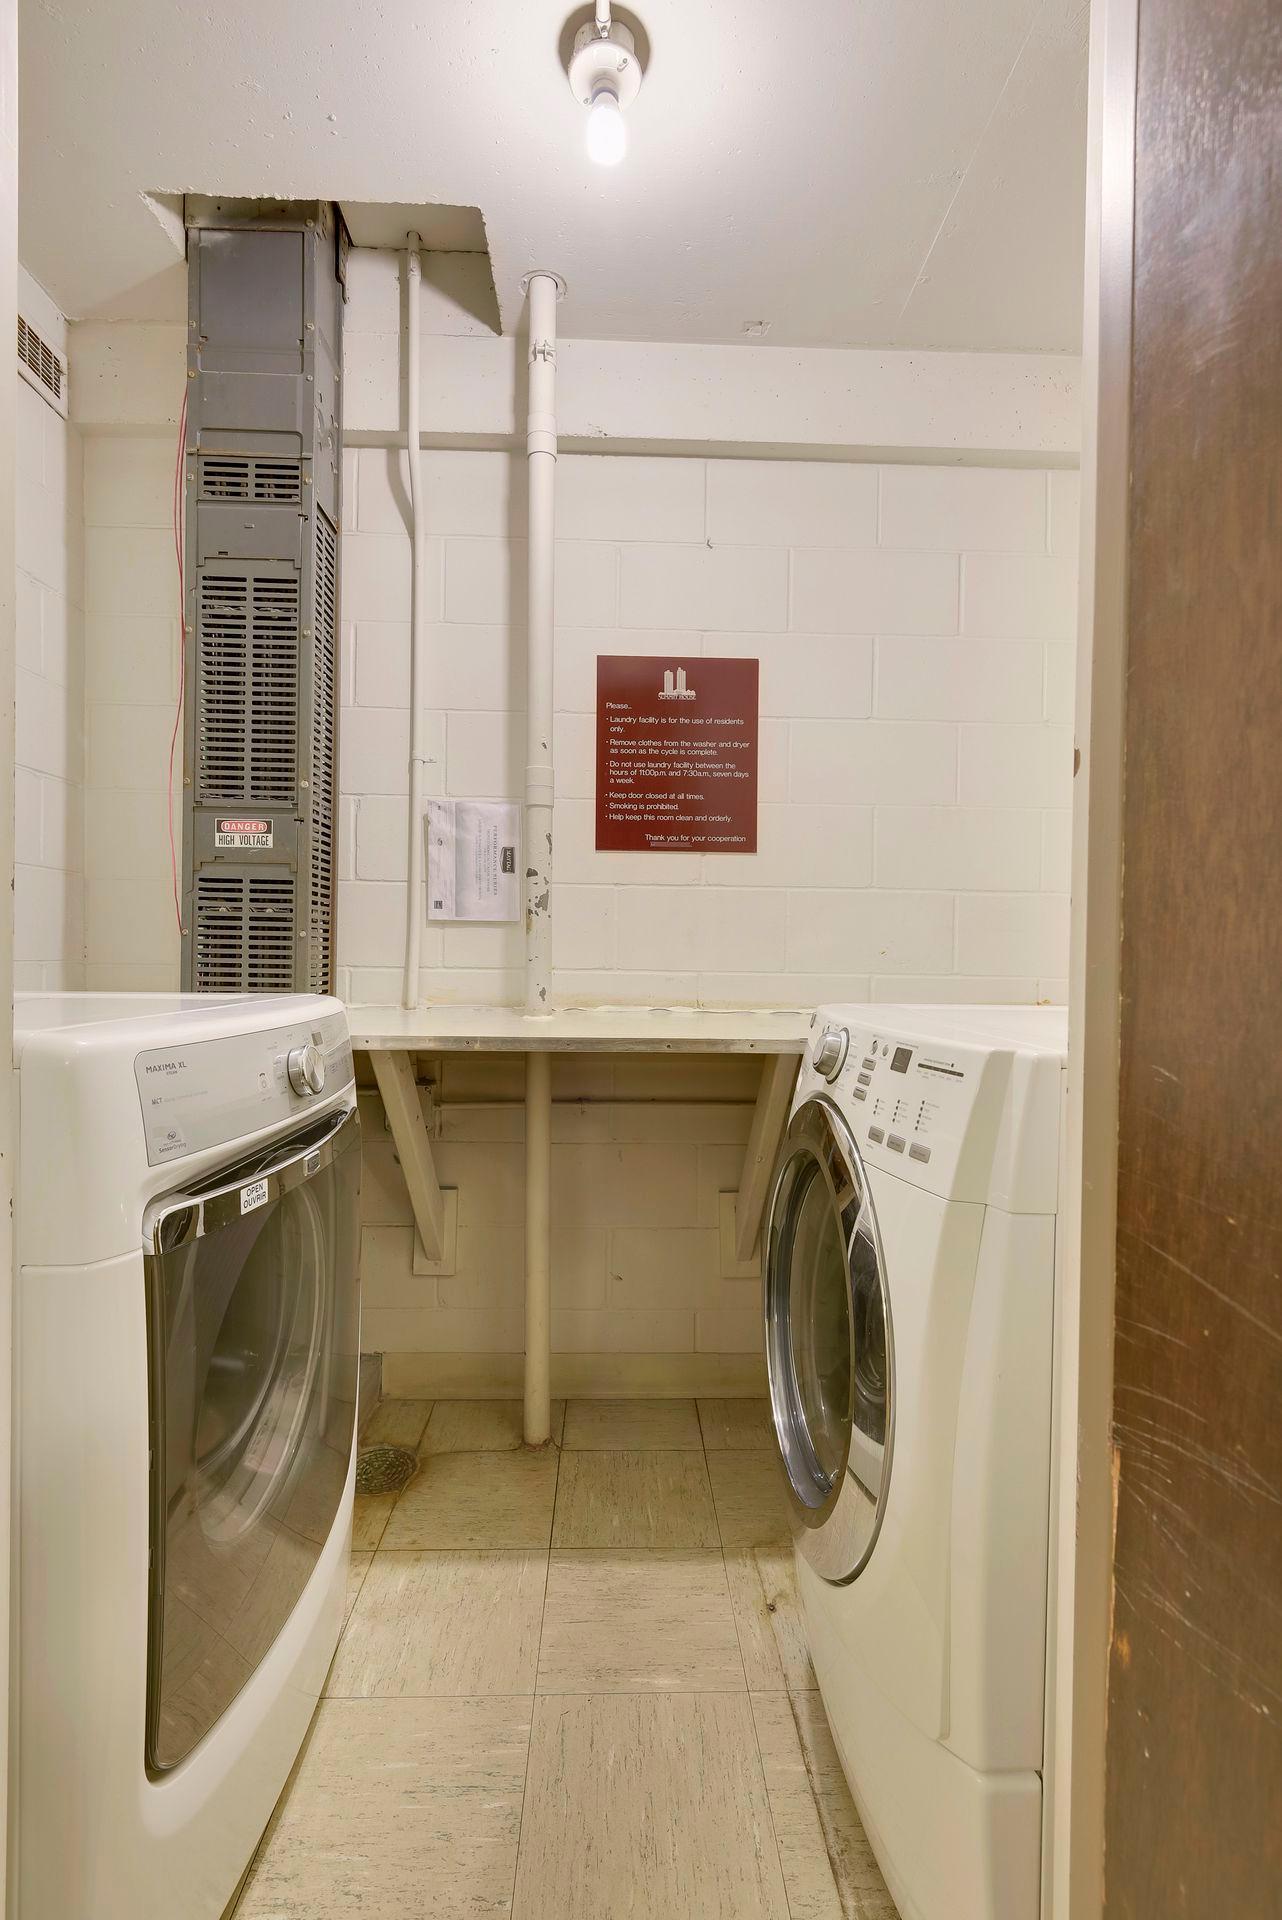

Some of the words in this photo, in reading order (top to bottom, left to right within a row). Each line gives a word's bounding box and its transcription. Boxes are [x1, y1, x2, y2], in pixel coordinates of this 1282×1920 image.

[610, 716, 636, 724] Laundry
[639, 716, 658, 724] facility
[661, 748, 678, 756] cycle
[648, 761, 671, 769] laundry
[674, 761, 693, 769] facility
[734, 770, 749, 778] days
[645, 792, 667, 800] closed
[609, 802, 638, 810] Smoking
[646, 803, 679, 811] prohibited.
[224, 823, 264, 831] DANGER
[218, 835, 235, 846] HIGH
[239, 835, 269, 846] VOLTAGE
[145, 1062, 177, 1074] MAXIMA
[177, 1061, 188, 1069] XL
[246, 1182, 264, 1197] OPEN
[243, 1191, 267, 1209] OUVRIR
